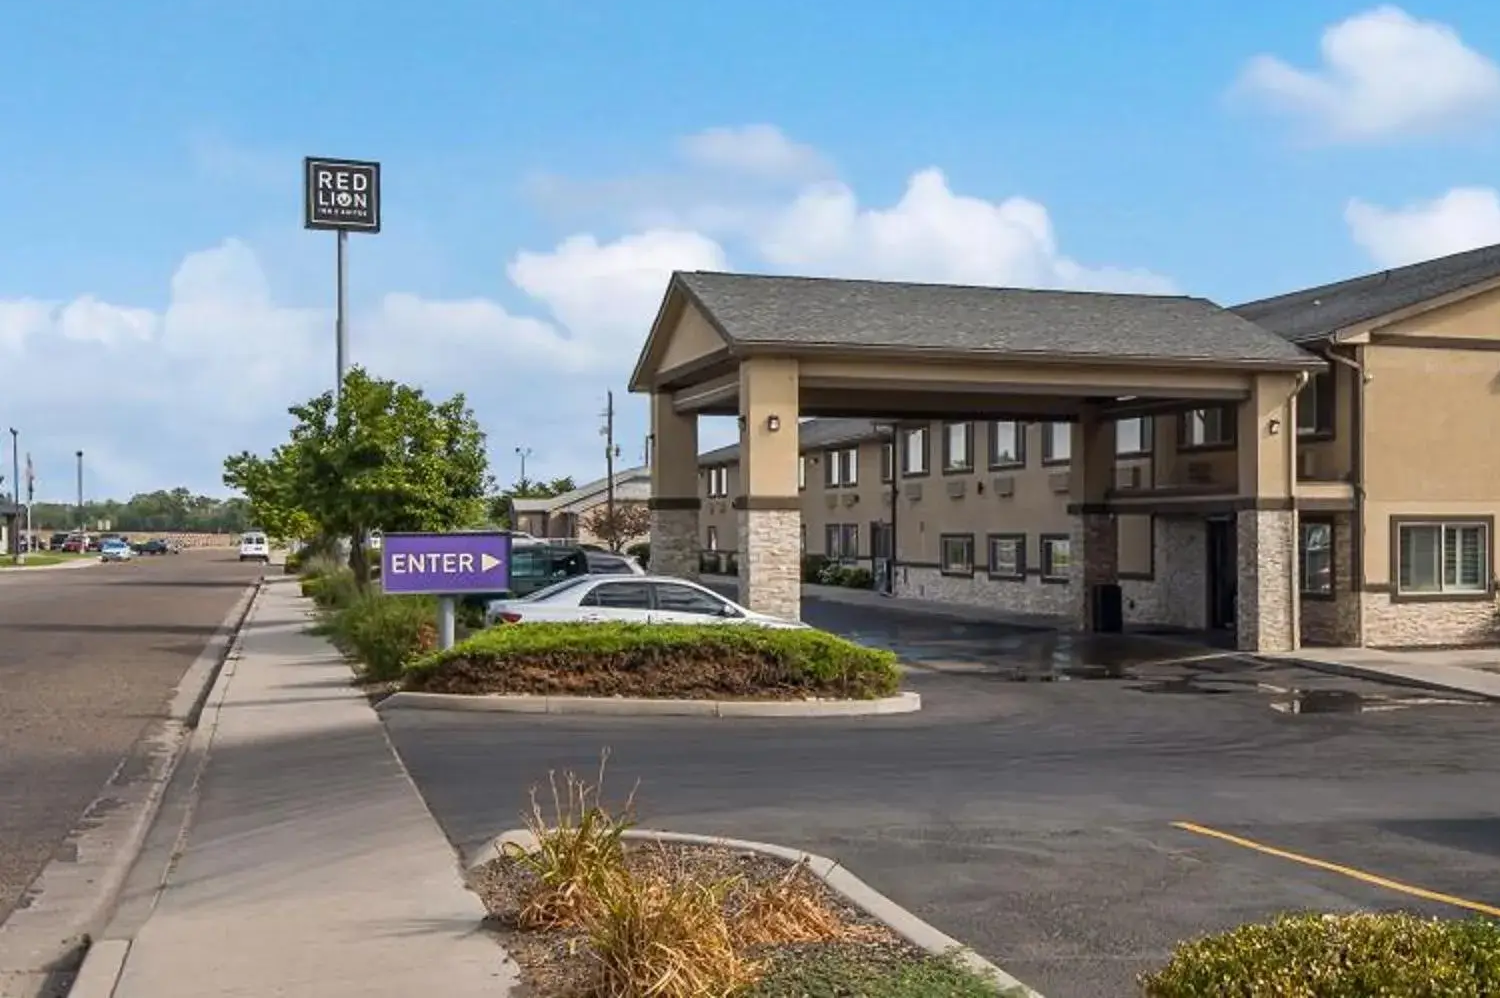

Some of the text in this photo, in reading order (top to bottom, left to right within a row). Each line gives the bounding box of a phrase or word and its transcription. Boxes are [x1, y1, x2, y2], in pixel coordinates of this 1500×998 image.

[319, 170, 367, 191] RED
[319, 190, 367, 208] LION
[391, 553, 475, 574] ENTER
